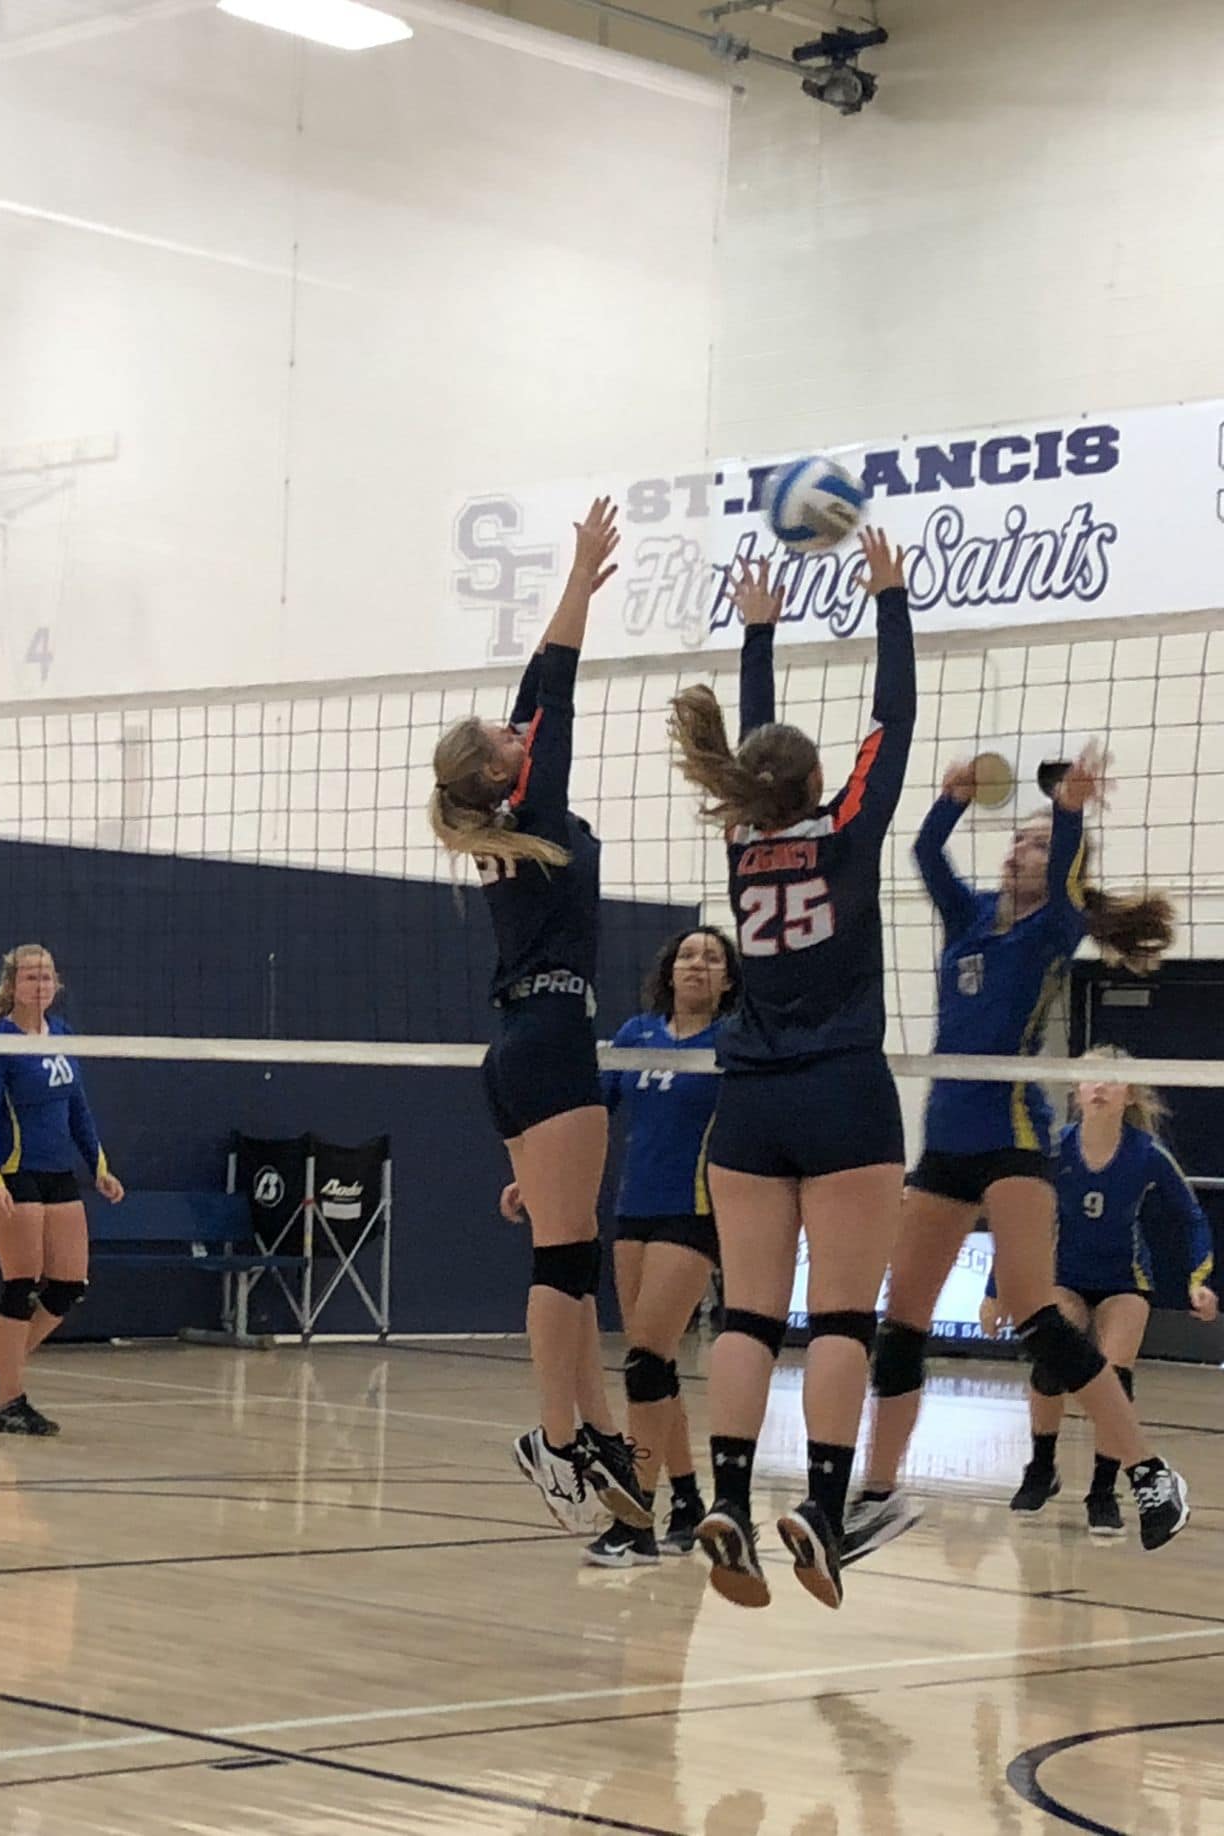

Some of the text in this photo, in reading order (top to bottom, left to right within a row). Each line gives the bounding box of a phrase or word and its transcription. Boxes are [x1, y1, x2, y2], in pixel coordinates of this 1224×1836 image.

[902, 501, 1119, 612] Saints
[25, 625, 54, 687] 4
[739, 876, 836, 957] 25
[41, 1053, 74, 1088] 20
[1082, 1190, 1105, 1220] 9
